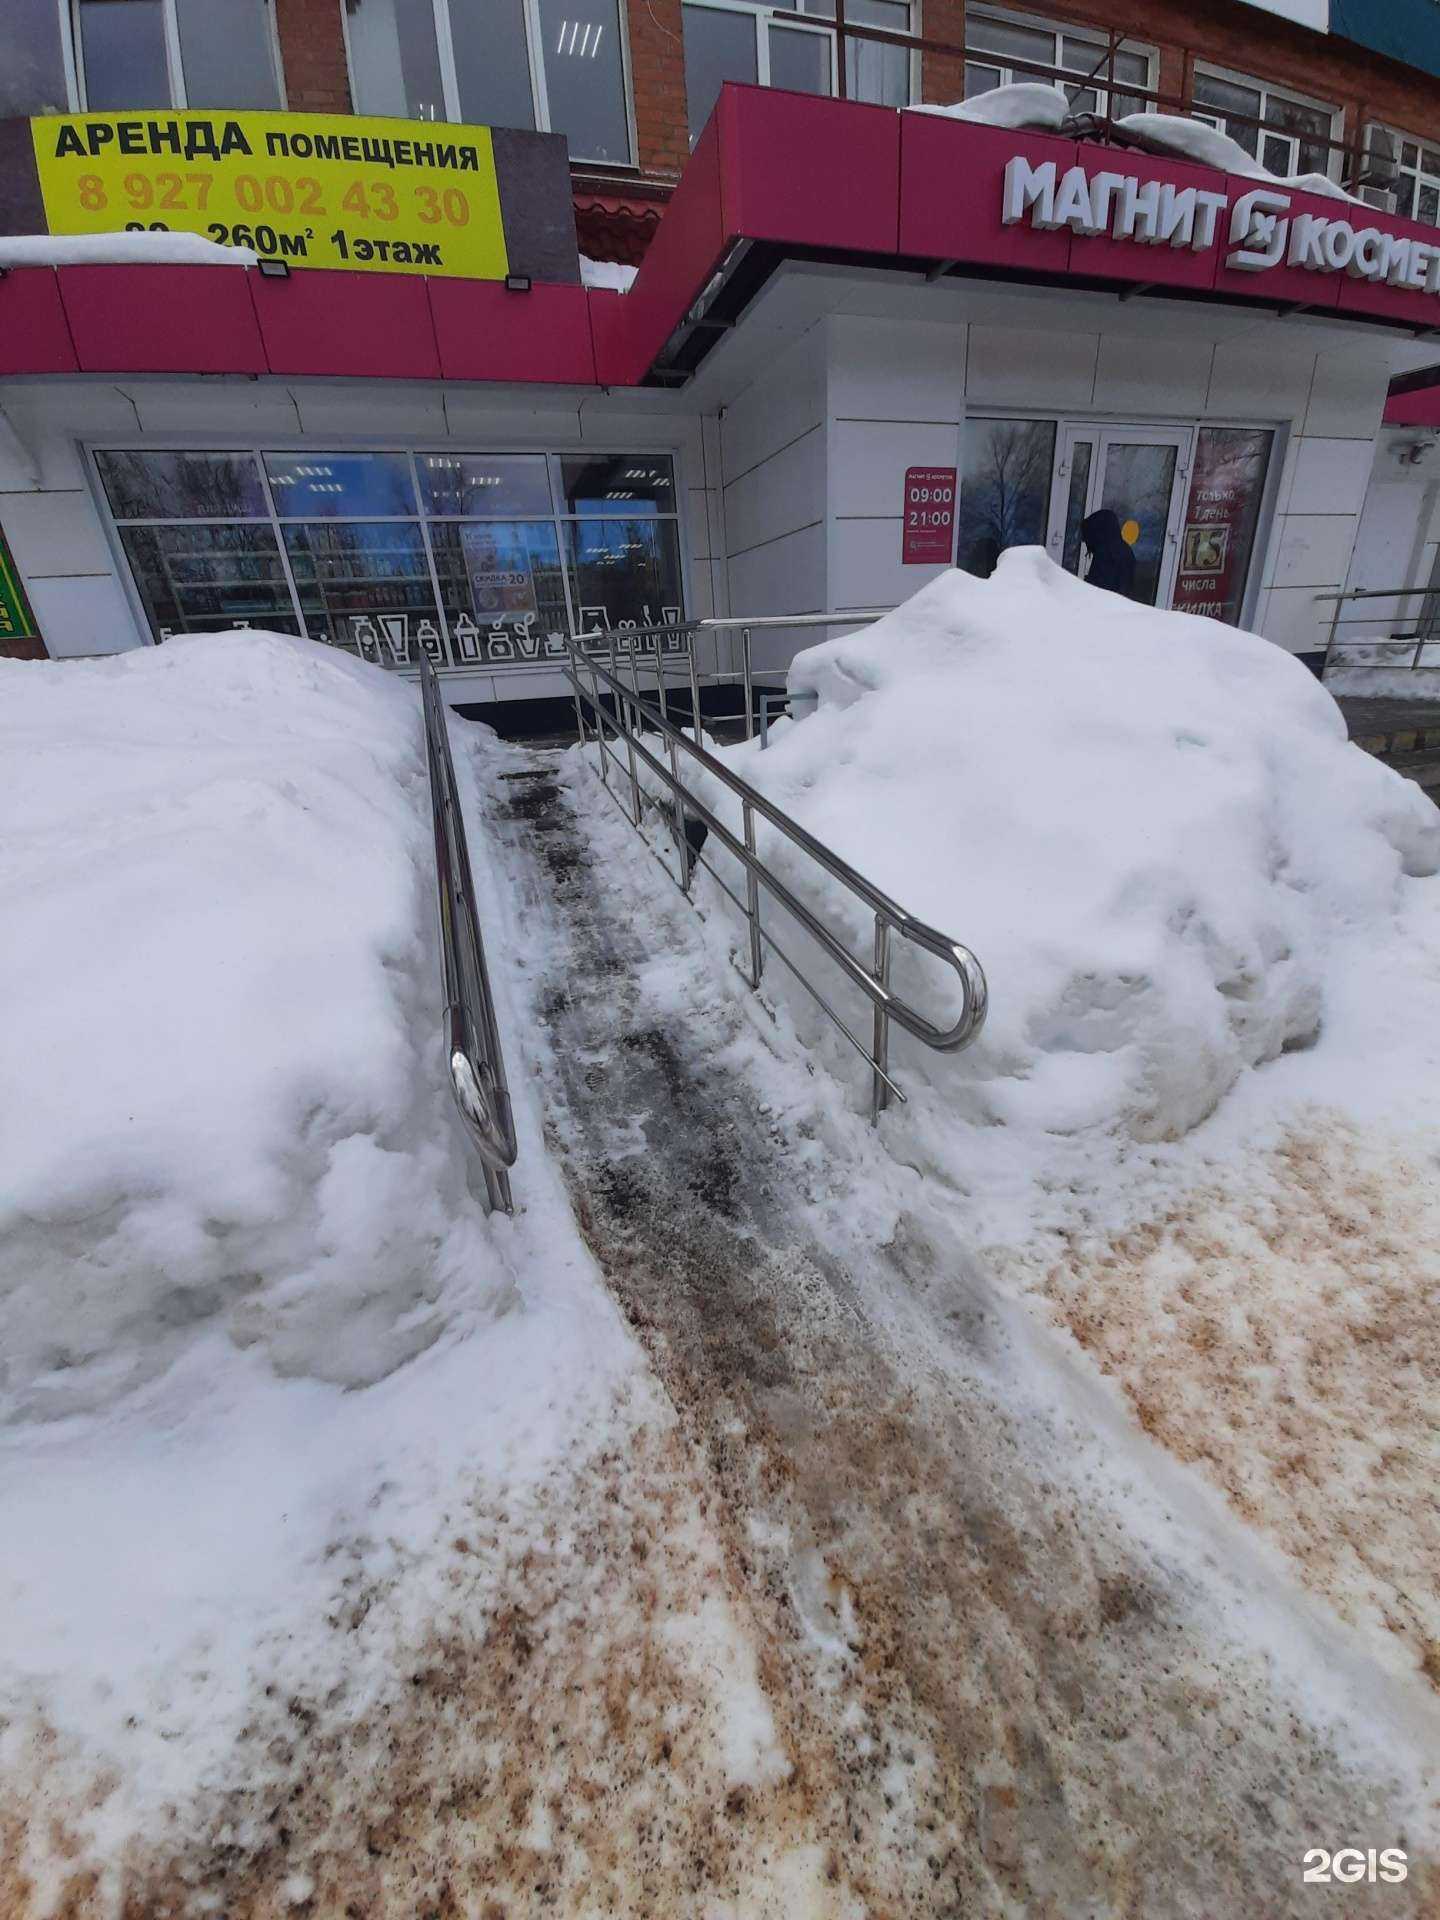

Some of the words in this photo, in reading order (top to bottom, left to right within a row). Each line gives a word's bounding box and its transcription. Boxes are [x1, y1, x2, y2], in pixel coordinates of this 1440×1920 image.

[55, 121, 253, 161] АРЕНДА
[265, 132, 480, 172] ПОМЕЩЕНИЯ
[77, 173, 107, 211] 8
[122, 173, 214, 210] 927
[234, 174, 327, 217] 002
[342, 180, 399, 221] 43
[414, 185, 470, 227] 30
[1002, 156, 1228, 251] МАГНИТ
[910, 488, 952, 503] 09:00
[910, 511, 951, 525] 21:00
[1184, 530, 1224, 567] 15
[1182, 579, 1217, 592] числа
[1173, 601, 1223, 617] КИДКА
